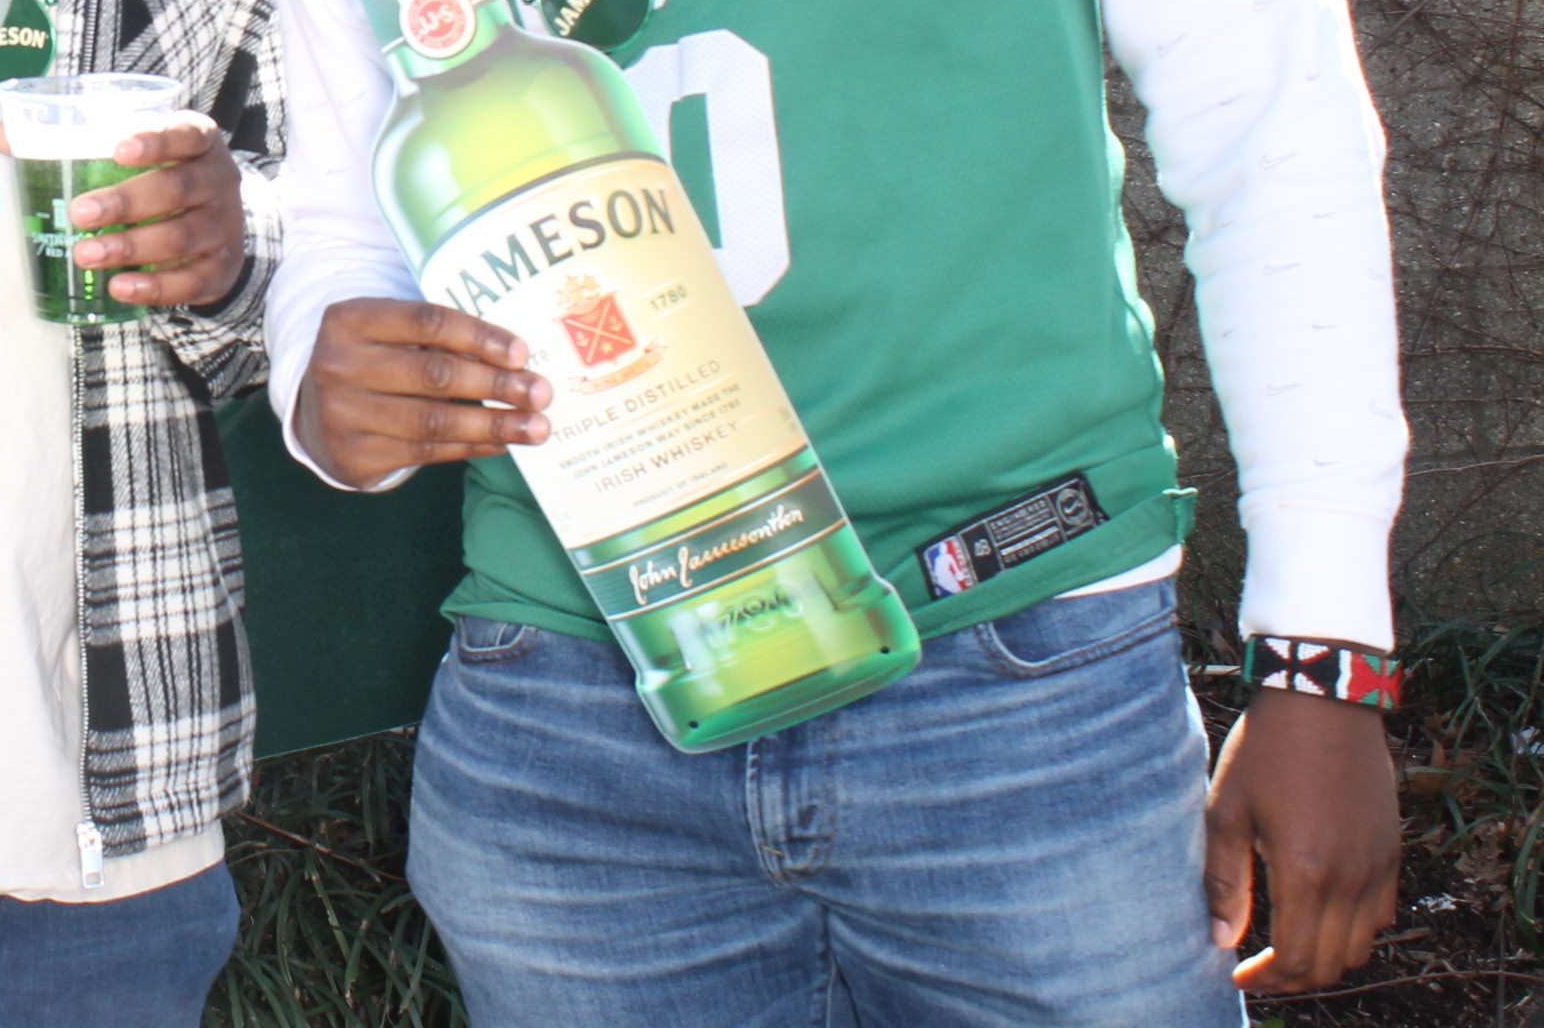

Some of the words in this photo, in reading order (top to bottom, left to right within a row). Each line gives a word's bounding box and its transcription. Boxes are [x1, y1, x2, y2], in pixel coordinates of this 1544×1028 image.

[446, 187, 676, 320] JAMESON
[552, 406, 620, 444] TRIPLE
[623, 359, 722, 414] DISTILLED
[594, 461, 648, 493] IRISH
[649, 420, 739, 470] WHISKEY
